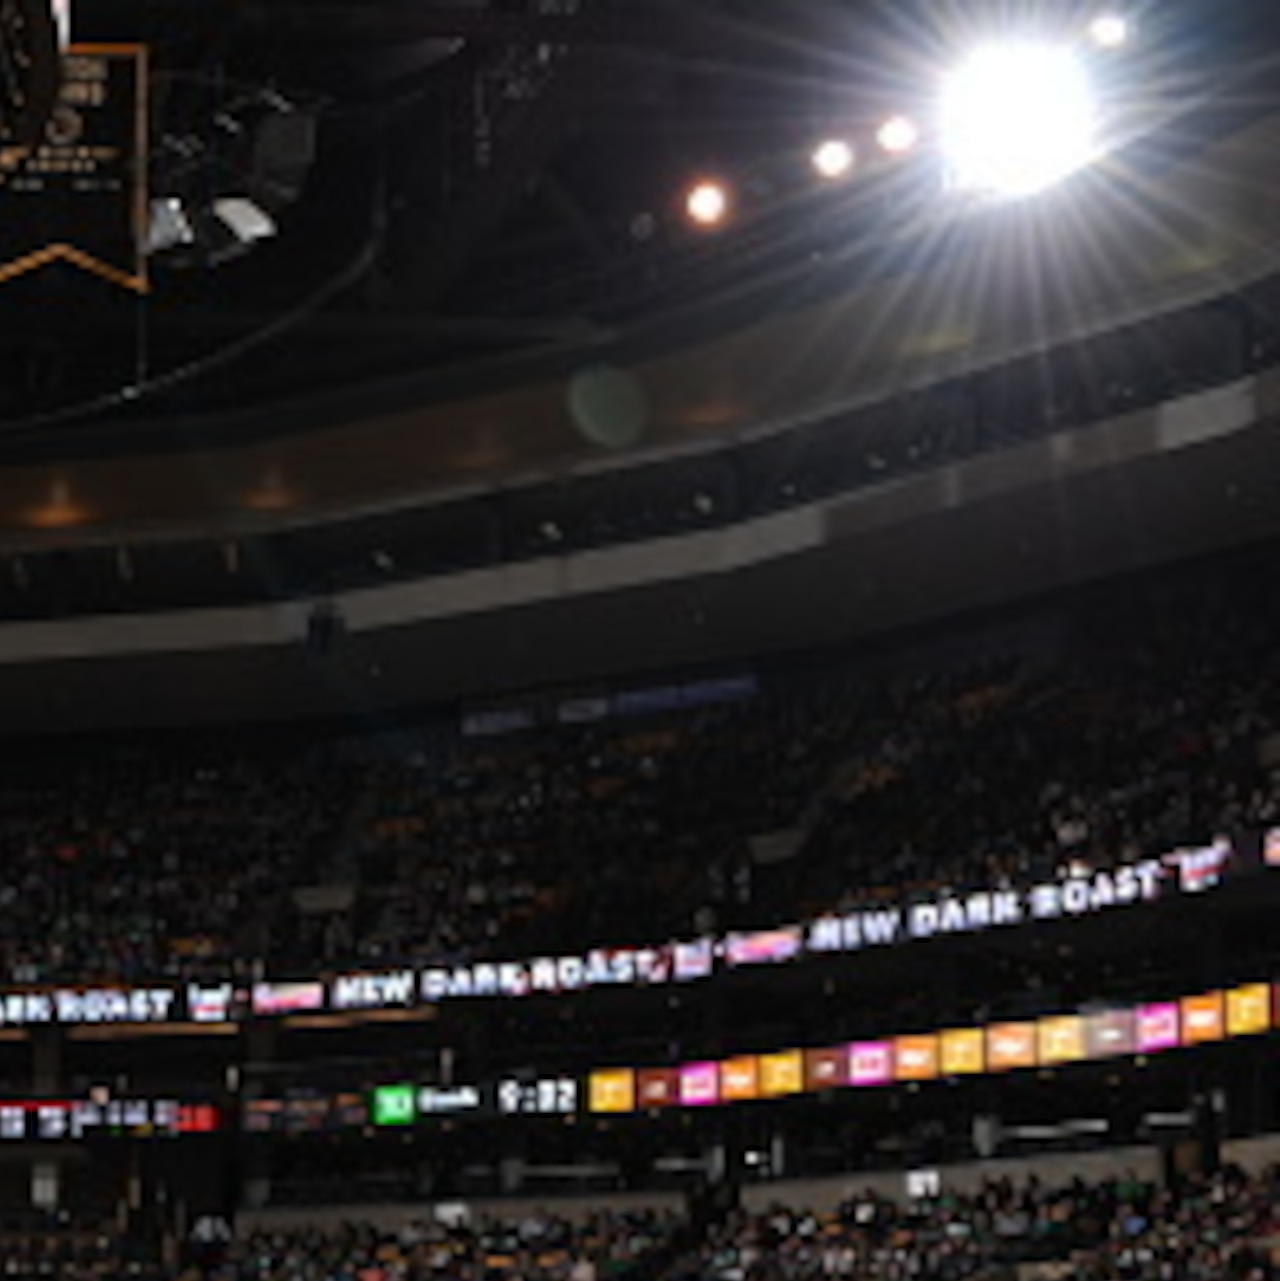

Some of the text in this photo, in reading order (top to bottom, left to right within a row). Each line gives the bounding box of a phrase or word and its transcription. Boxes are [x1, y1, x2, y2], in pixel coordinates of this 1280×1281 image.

[809, 908, 899, 951] NEW
[909, 891, 1021, 937] DARK
[1031, 859, 1160, 919] ROAST
[56, 987, 174, 1022] ROAST
[333, 971, 414, 1007] NEW
